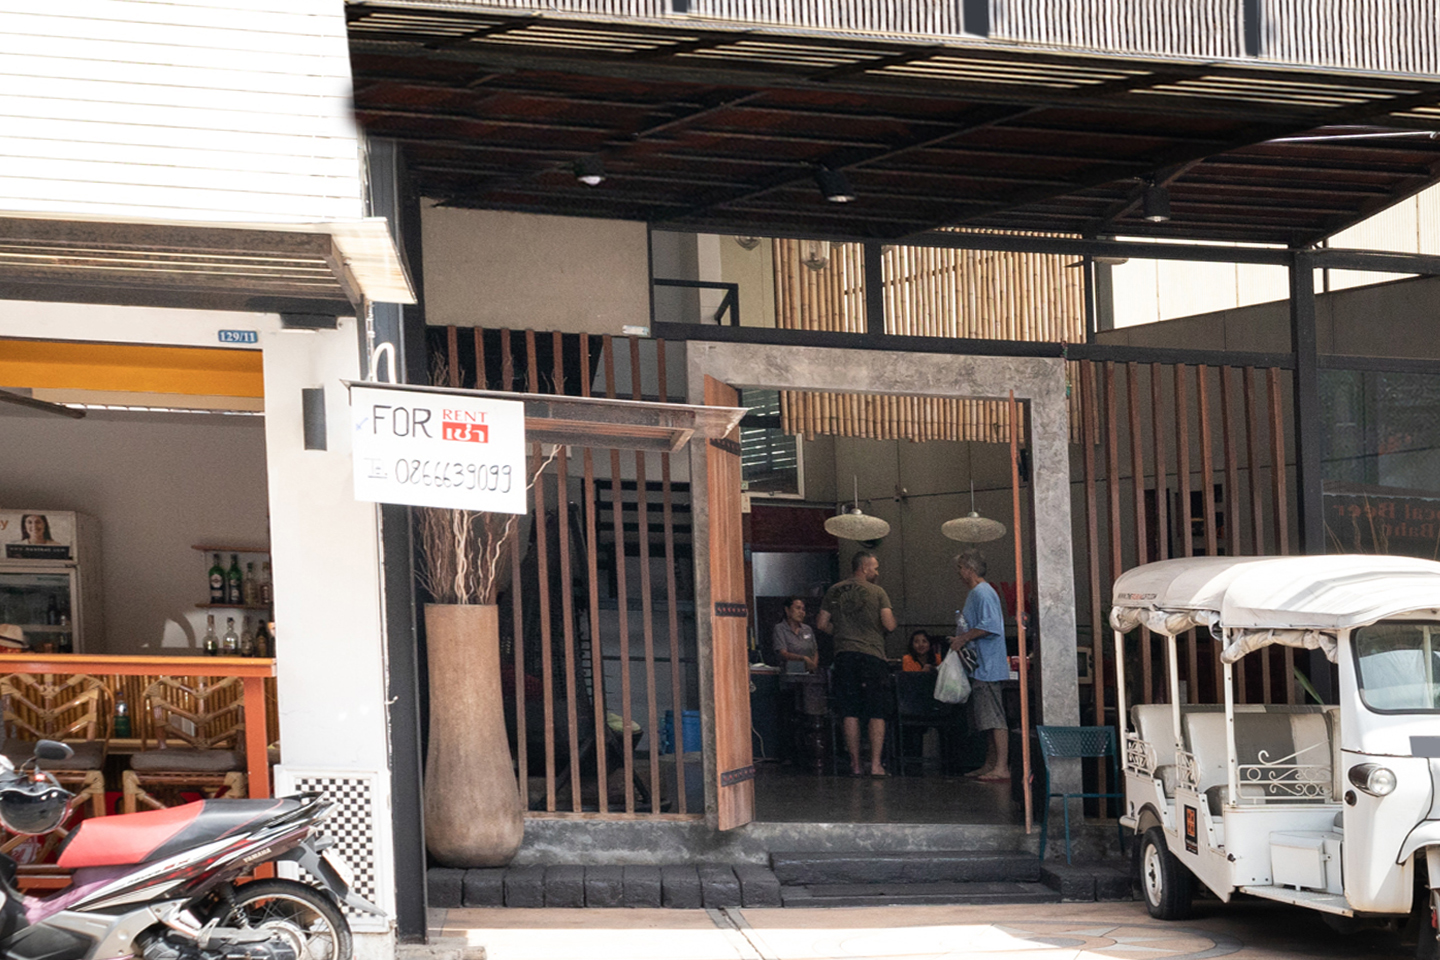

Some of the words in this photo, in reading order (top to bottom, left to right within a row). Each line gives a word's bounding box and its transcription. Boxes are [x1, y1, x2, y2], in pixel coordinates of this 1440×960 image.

[220, 331, 256, 342] 129/11
[373, 404, 433, 438] FOR
[442, 408, 488, 423] RENT
[395, 458, 512, 493] 0866639099
